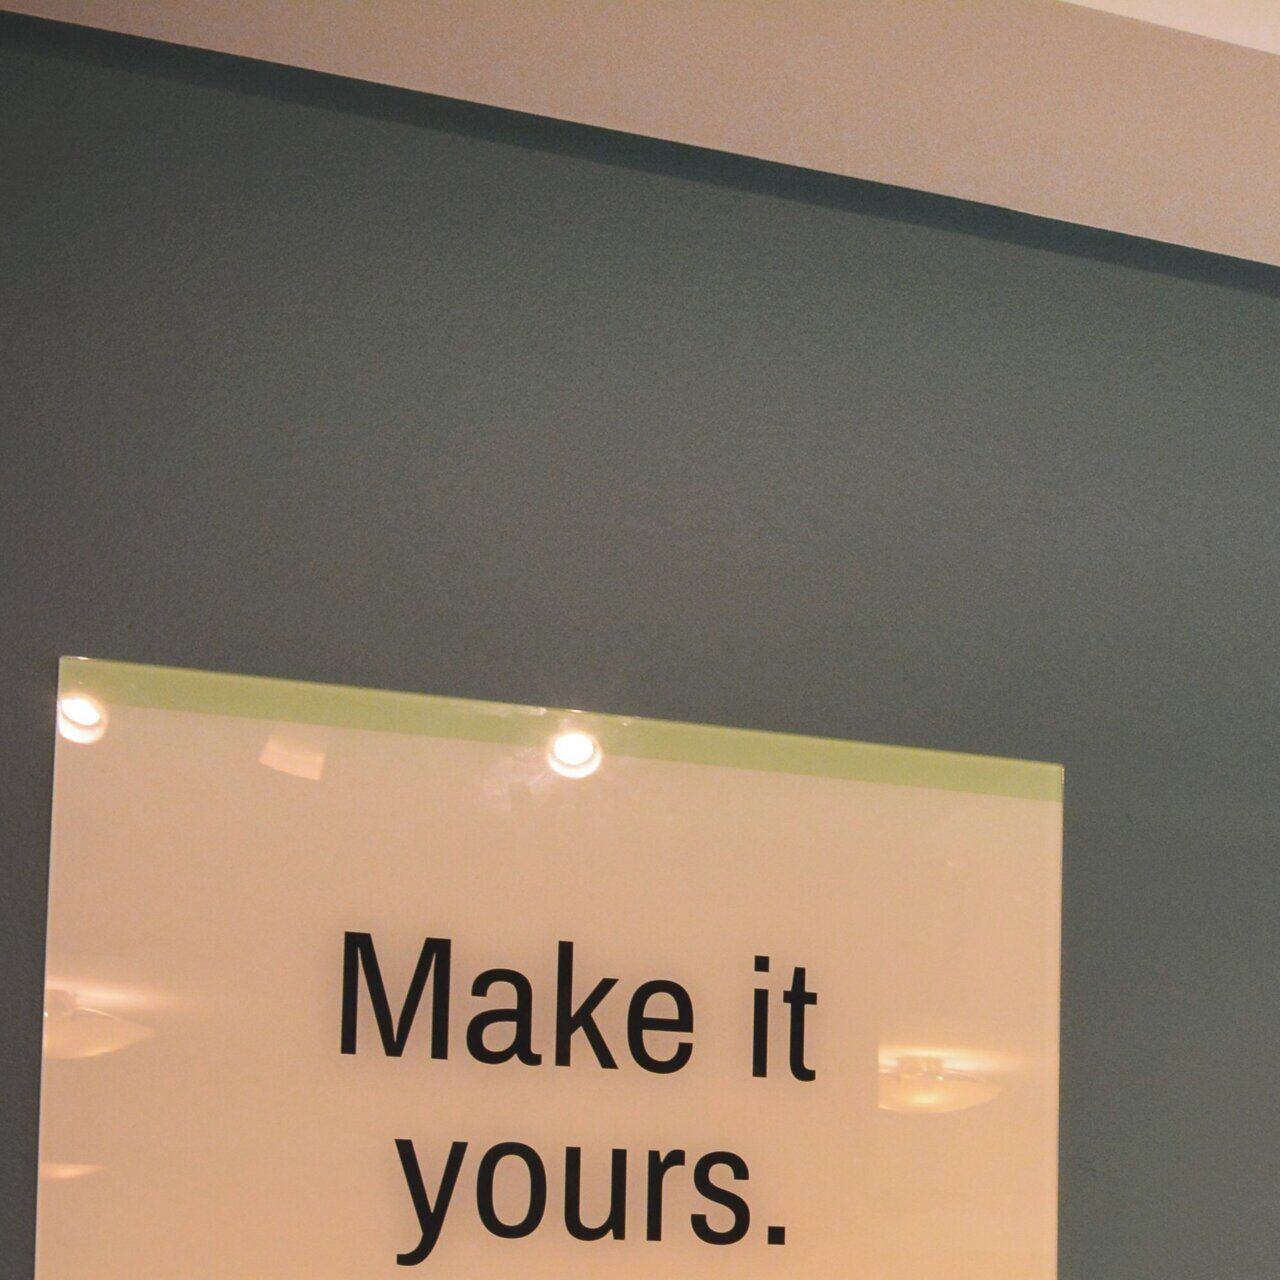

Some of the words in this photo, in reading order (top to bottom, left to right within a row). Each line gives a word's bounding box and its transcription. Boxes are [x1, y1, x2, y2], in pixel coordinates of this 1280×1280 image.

[340, 931, 694, 1075] Make
[752, 955, 818, 1083] it
[394, 1138, 786, 1267] yours.
